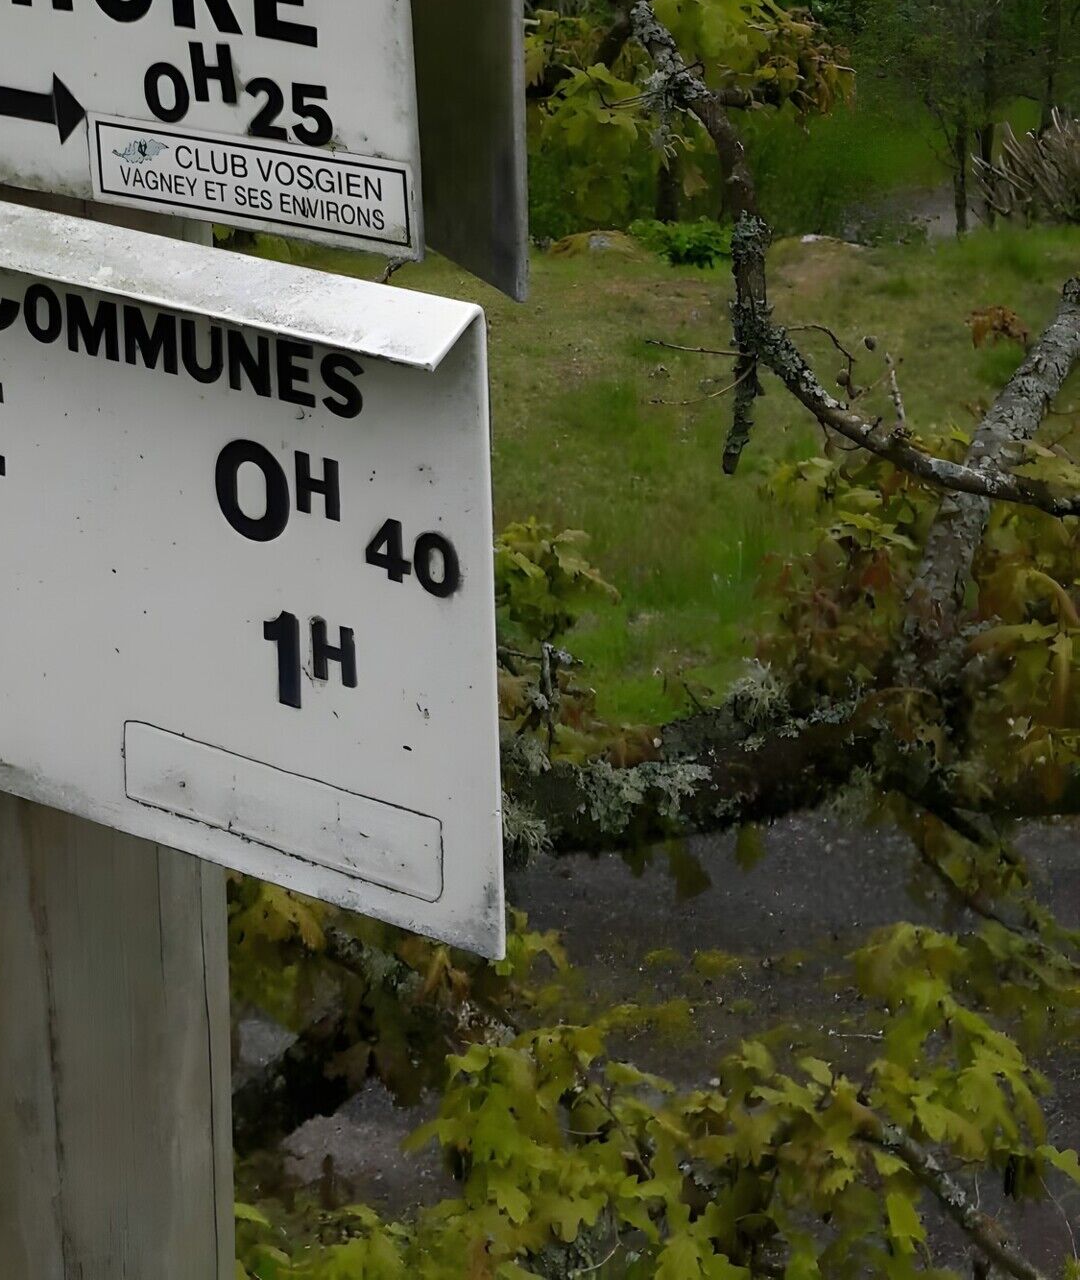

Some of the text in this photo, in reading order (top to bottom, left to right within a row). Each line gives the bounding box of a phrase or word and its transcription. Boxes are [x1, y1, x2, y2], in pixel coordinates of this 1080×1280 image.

[119, 165, 384, 230] VAGNEY ET SES ENVIRONS
[175, 145, 382, 201] CLUB VOSGIEN
[365, 519, 461, 598] 40
